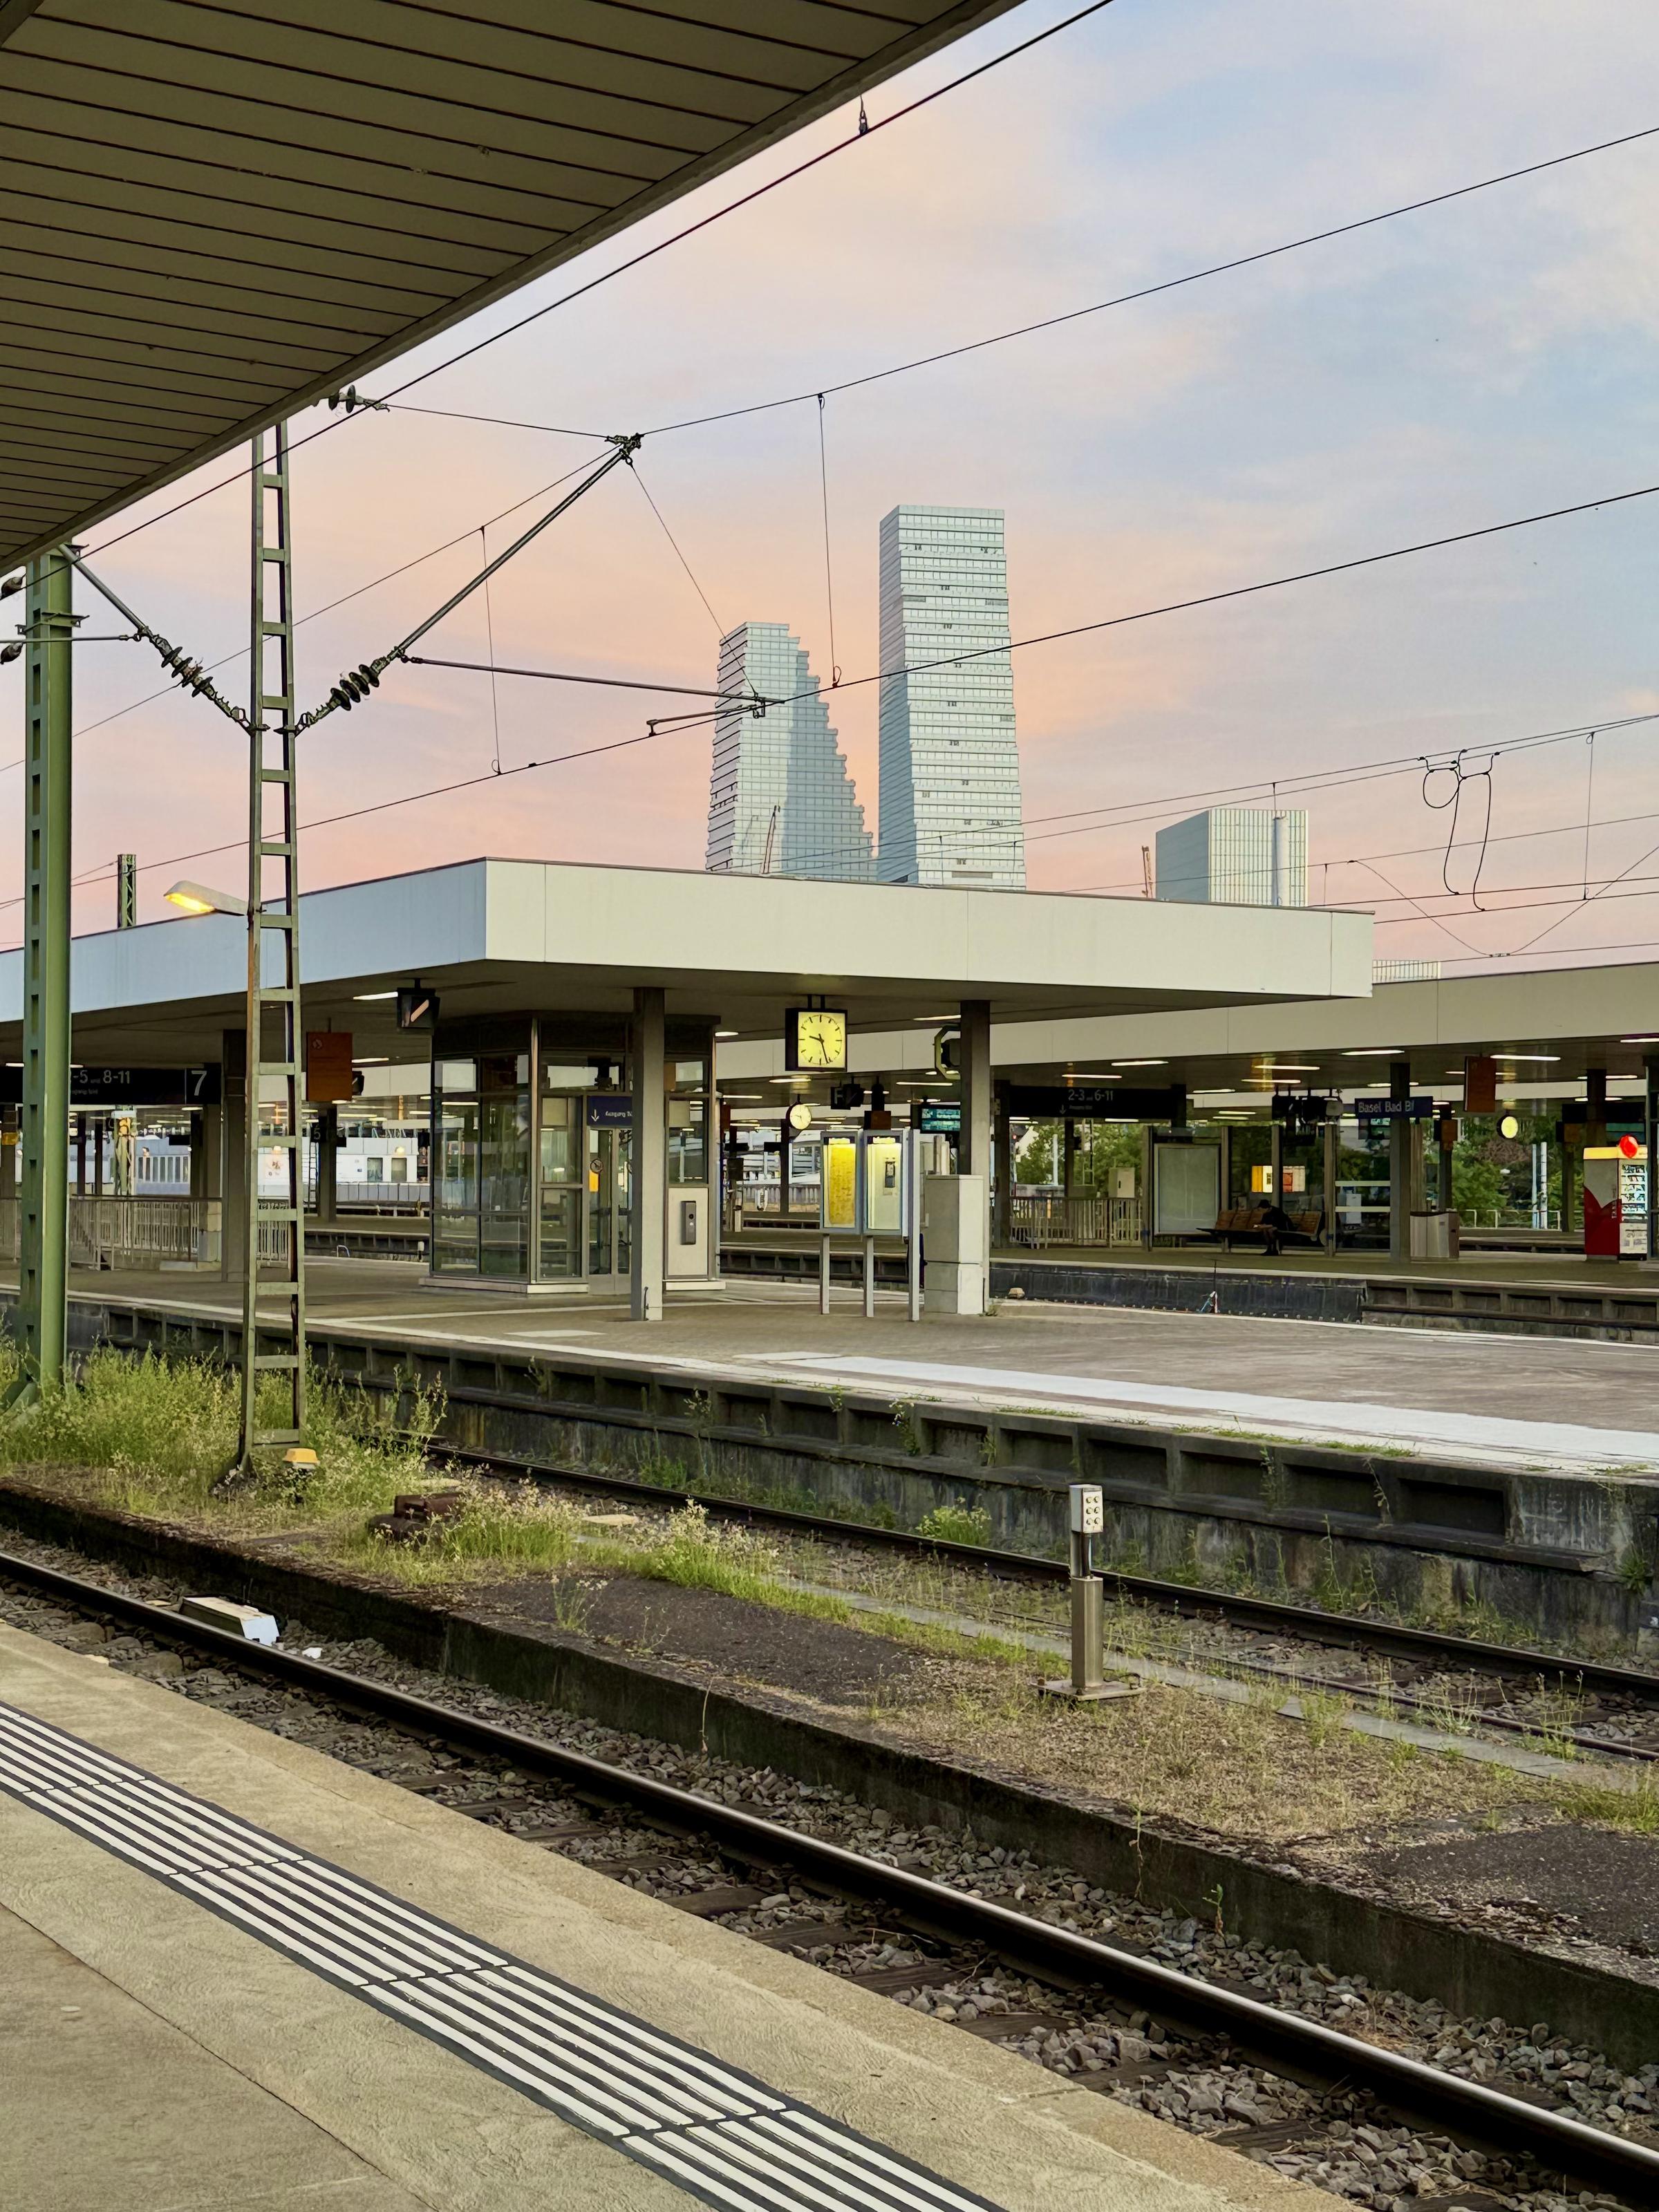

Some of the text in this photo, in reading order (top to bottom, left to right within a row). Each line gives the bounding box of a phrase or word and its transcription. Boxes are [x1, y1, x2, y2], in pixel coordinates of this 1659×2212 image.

[103, 1069, 131, 1084] 8-11
[191, 1070, 207, 1096] 7
[1068, 1089, 1114, 1101] 2-3 6-11
[1358, 1101, 1382, 1113] Basel
[1385, 1100, 1402, 1112] Bad
